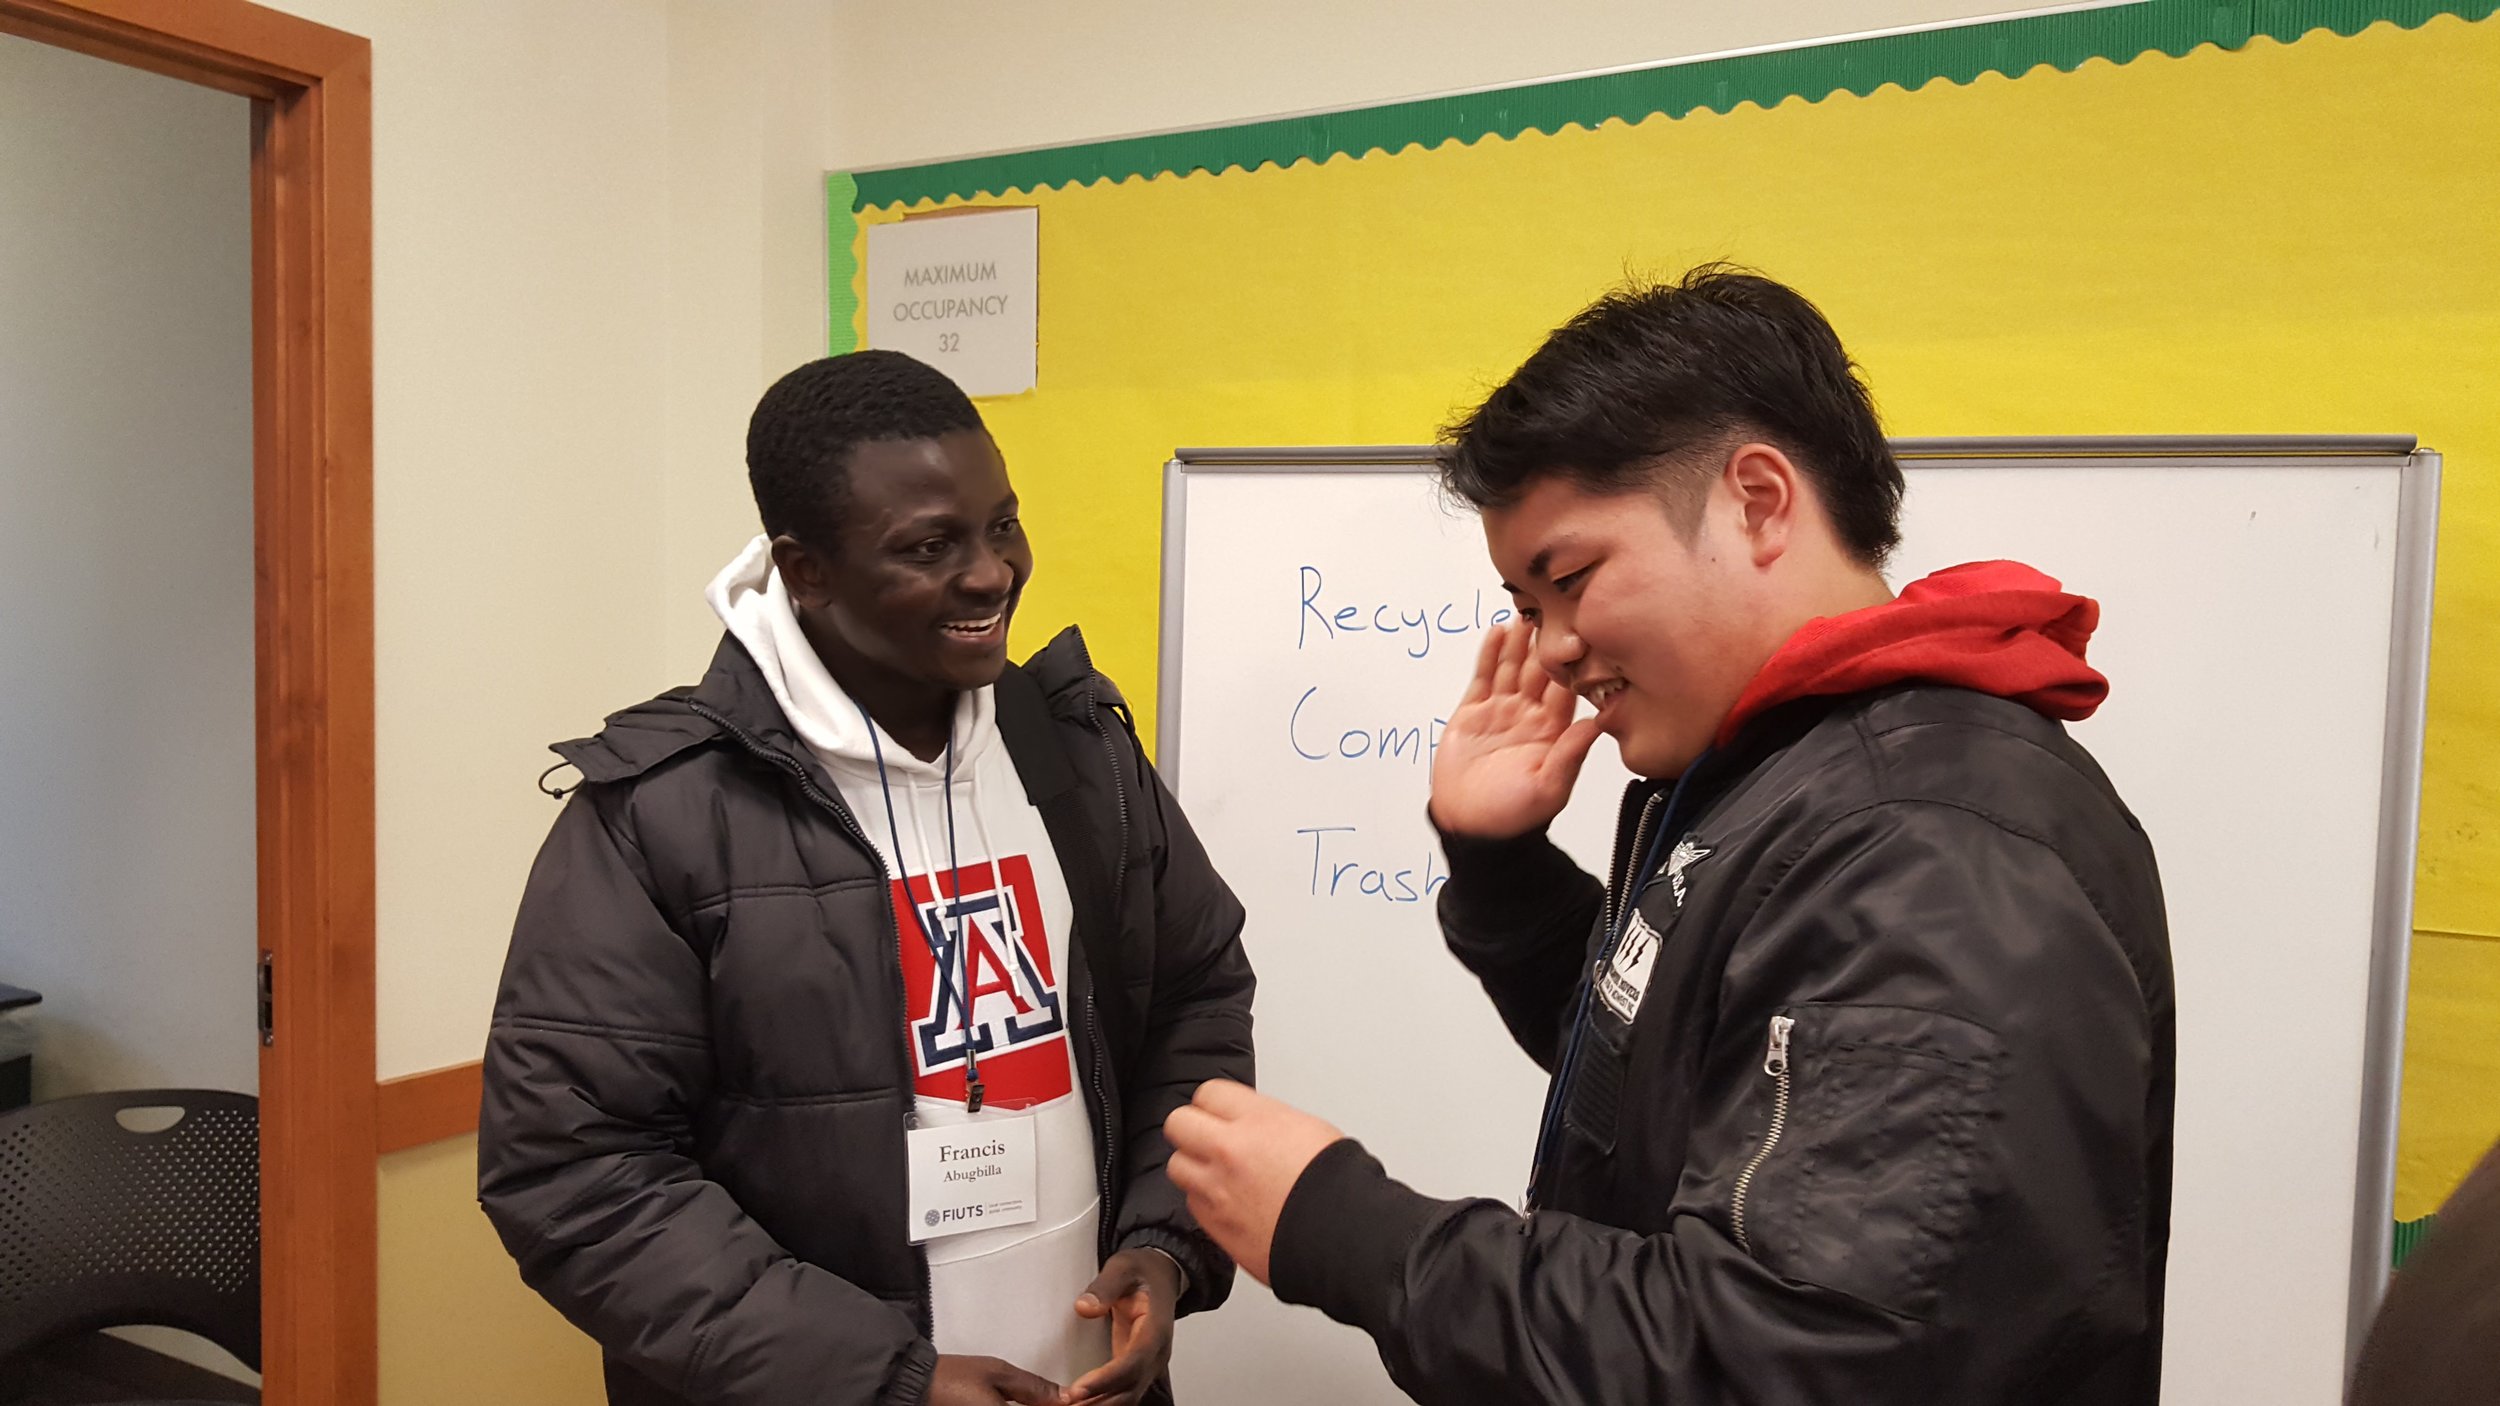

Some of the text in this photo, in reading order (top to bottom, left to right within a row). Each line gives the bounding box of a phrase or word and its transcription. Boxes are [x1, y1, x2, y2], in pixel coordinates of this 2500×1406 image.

[904, 260, 997, 288] MAXIMUM
[893, 295, 1008, 322] OCCUPANCY
[938, 333, 960, 352] 32
[1298, 566, 1511, 658] Recycle
[1297, 827, 1450, 903] Trash
[939, 1139, 1006, 1163] Francis
[943, 1165, 1002, 1182] Abugbilla
[942, 1205, 983, 1222] FIUTS
